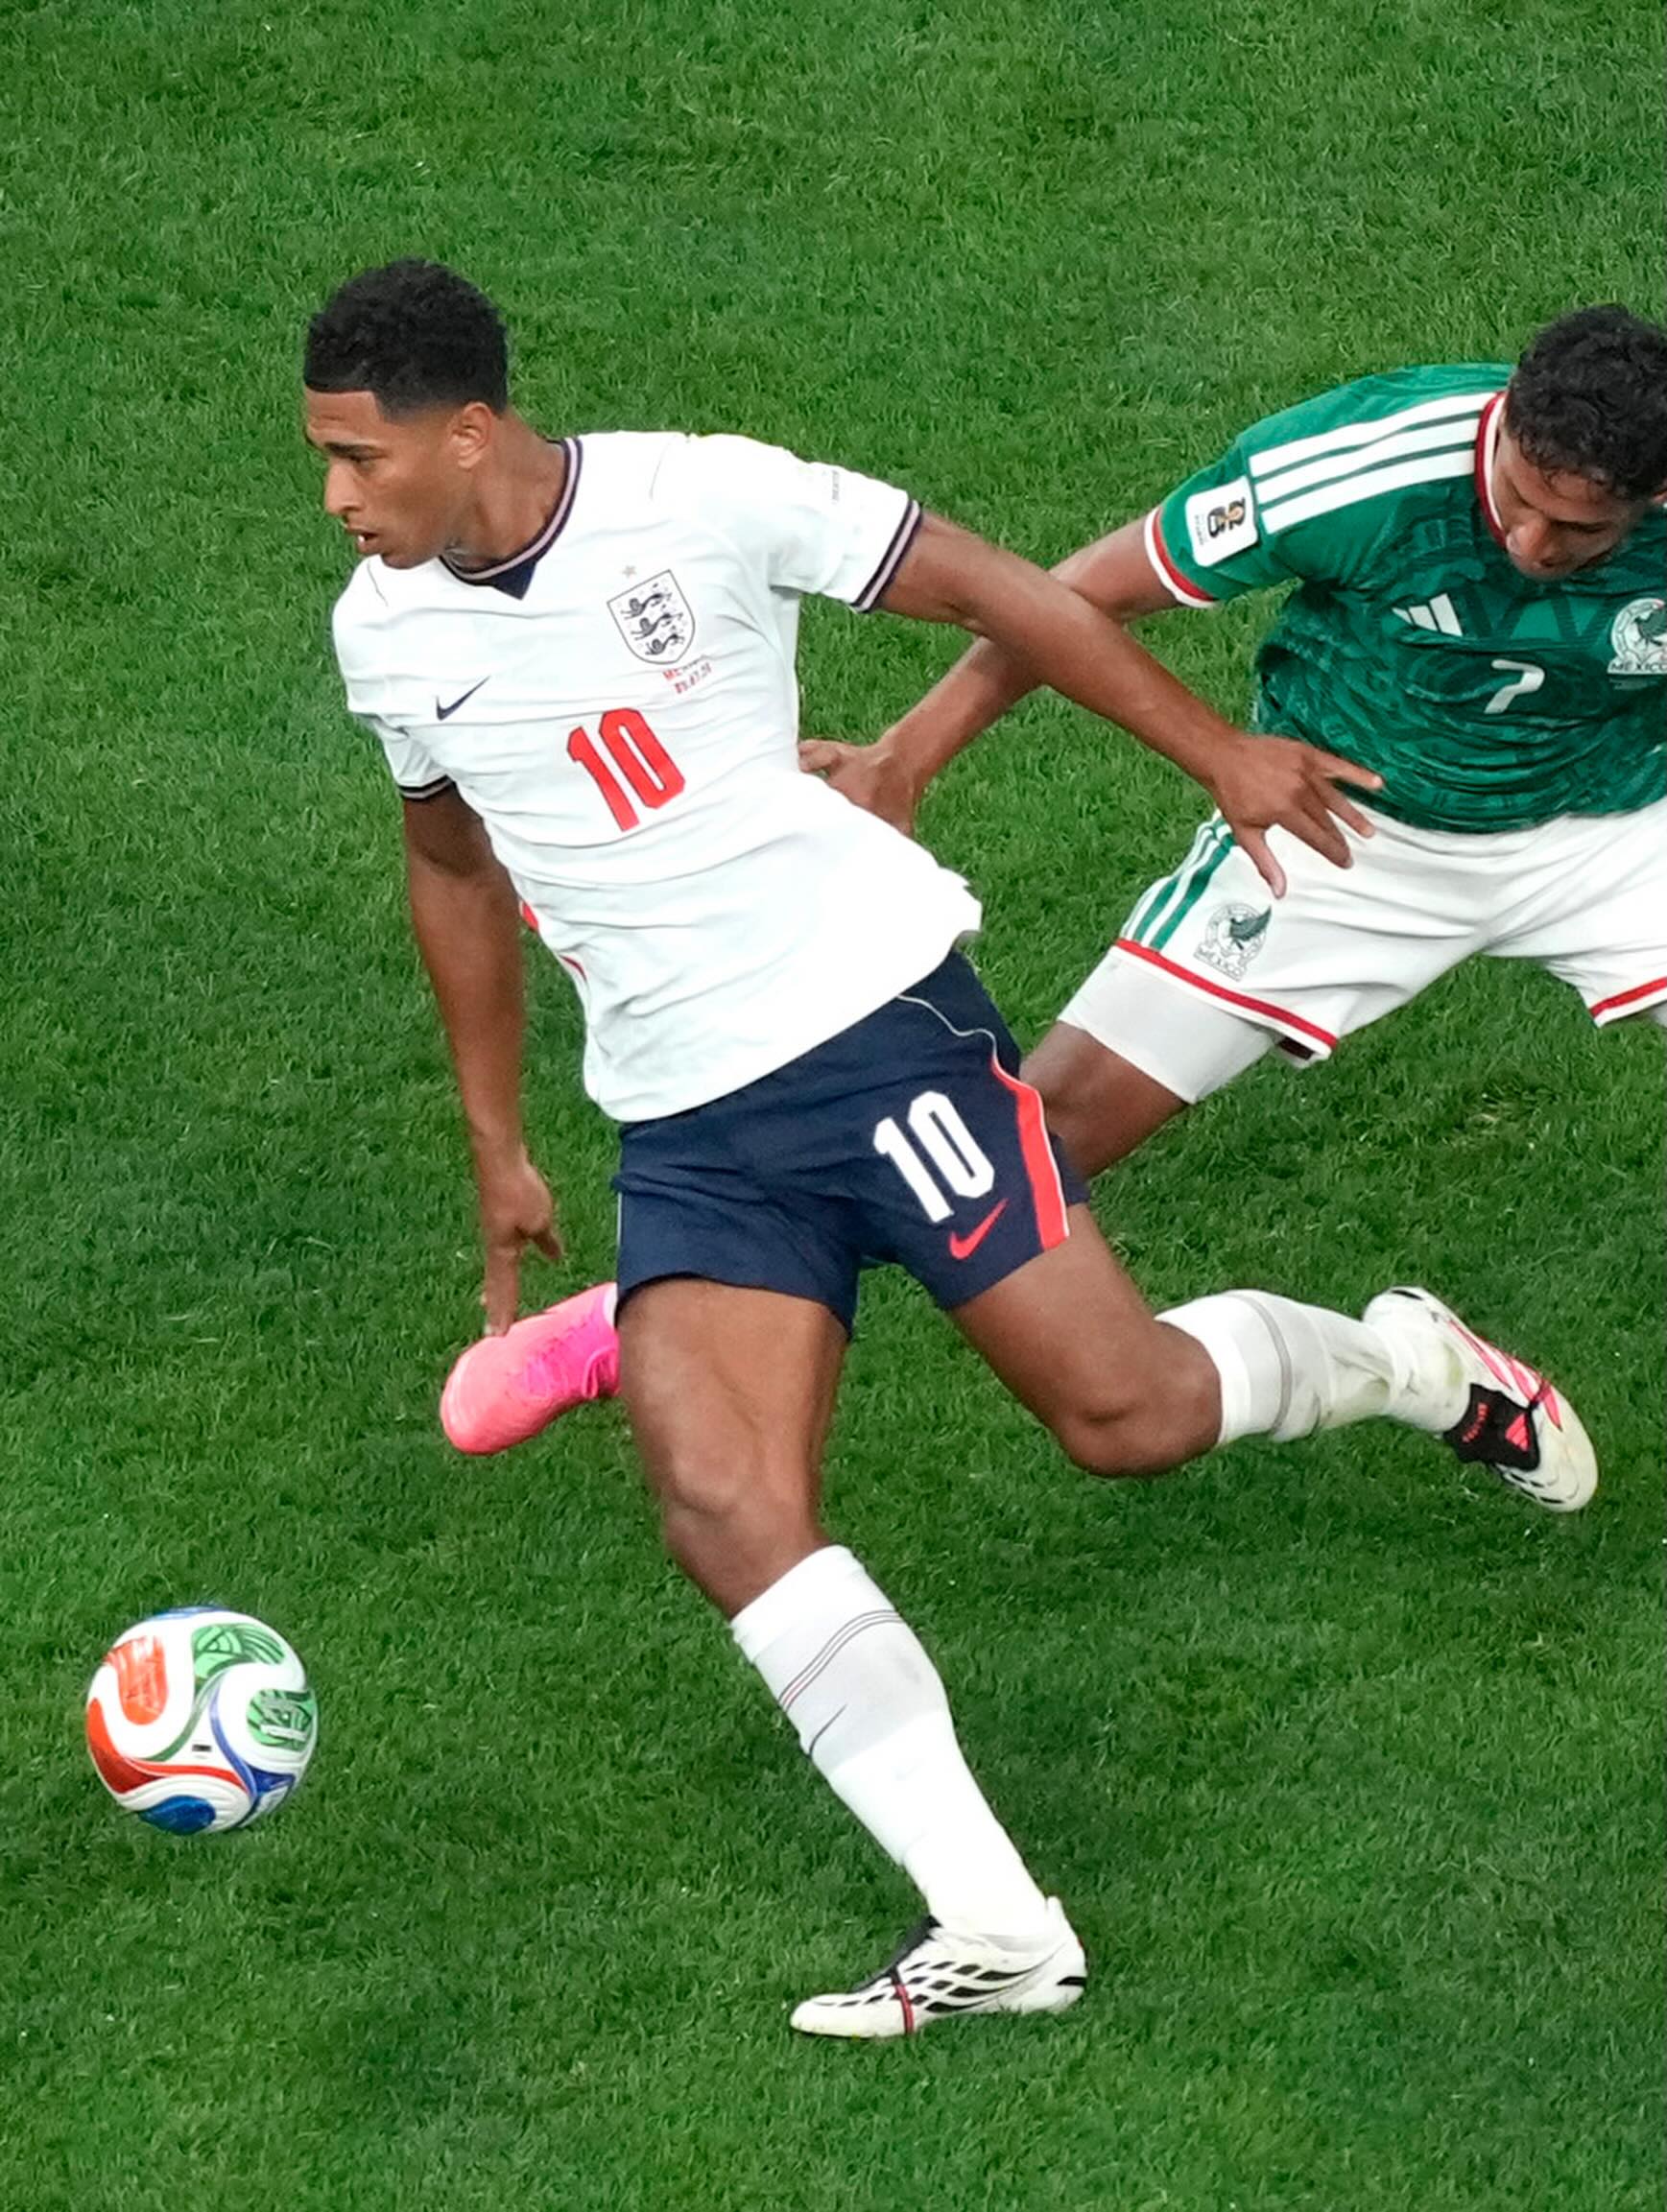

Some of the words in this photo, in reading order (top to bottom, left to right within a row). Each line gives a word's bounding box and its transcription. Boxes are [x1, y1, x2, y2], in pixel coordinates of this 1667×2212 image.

[1484, 659, 1545, 714] 7
[566, 707, 685, 832] 10
[873, 1090, 994, 1223] 10
